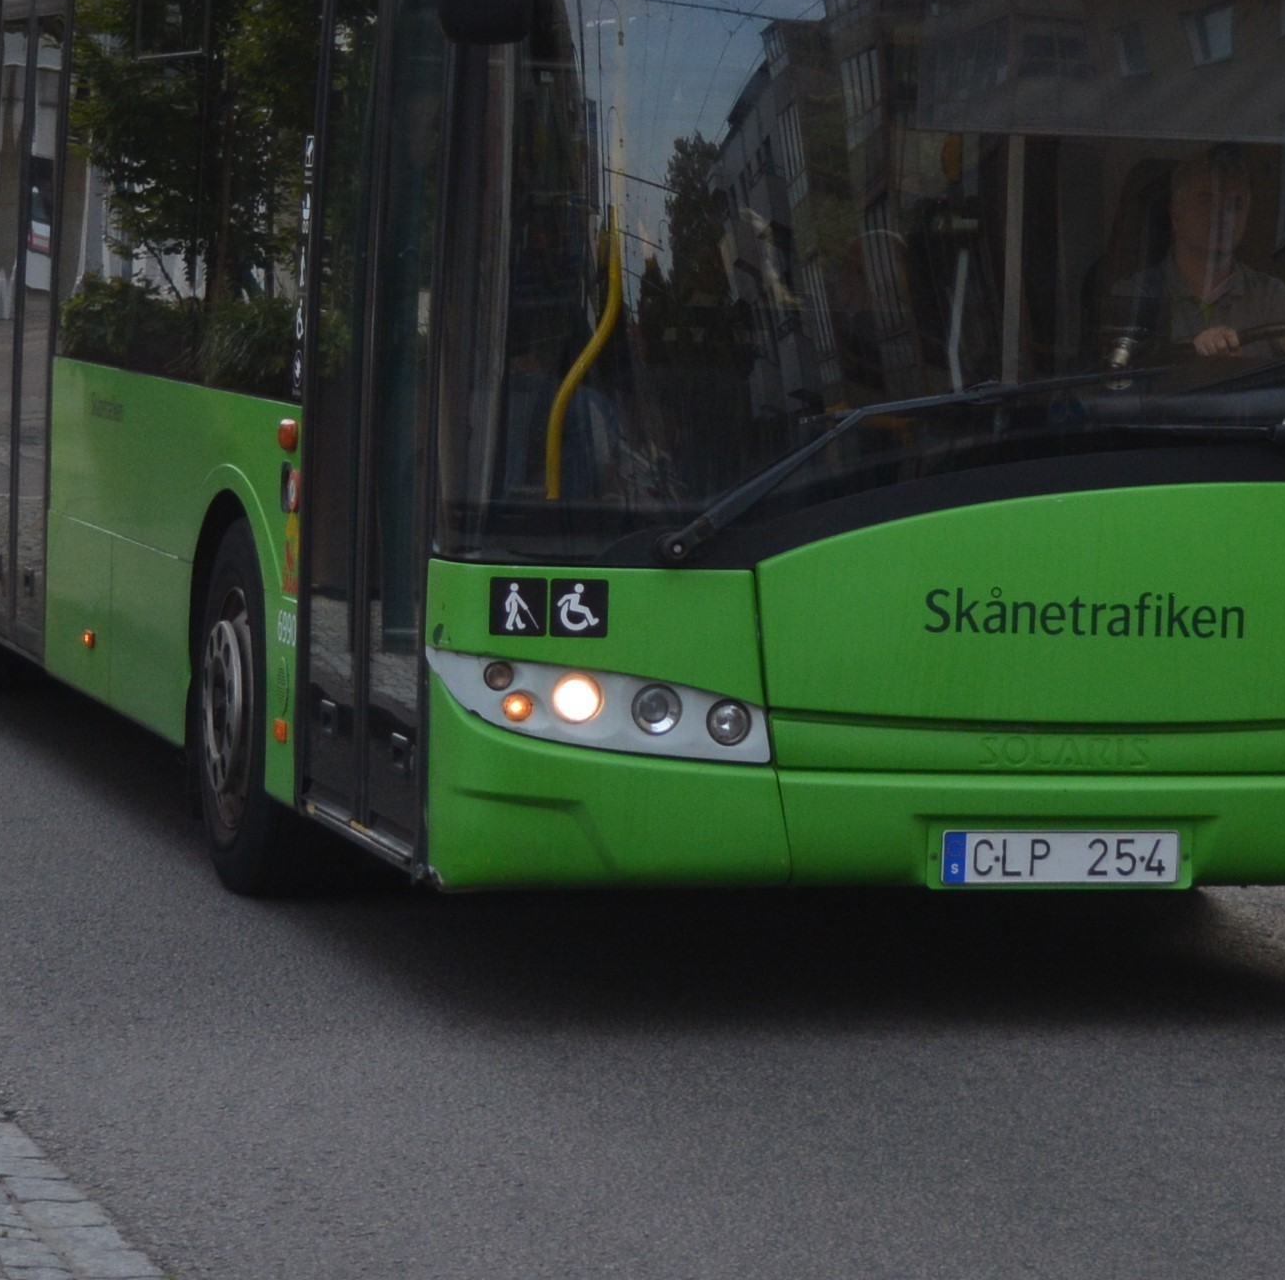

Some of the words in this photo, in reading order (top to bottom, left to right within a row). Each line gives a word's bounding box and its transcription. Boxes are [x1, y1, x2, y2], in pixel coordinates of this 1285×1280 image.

[924, 586, 1245, 640] Skånetrafiken
[978, 736, 1150, 768] SOLARIS
[972, 838, 1052, 877] CLP
[1086, 838, 1166, 877] 254
